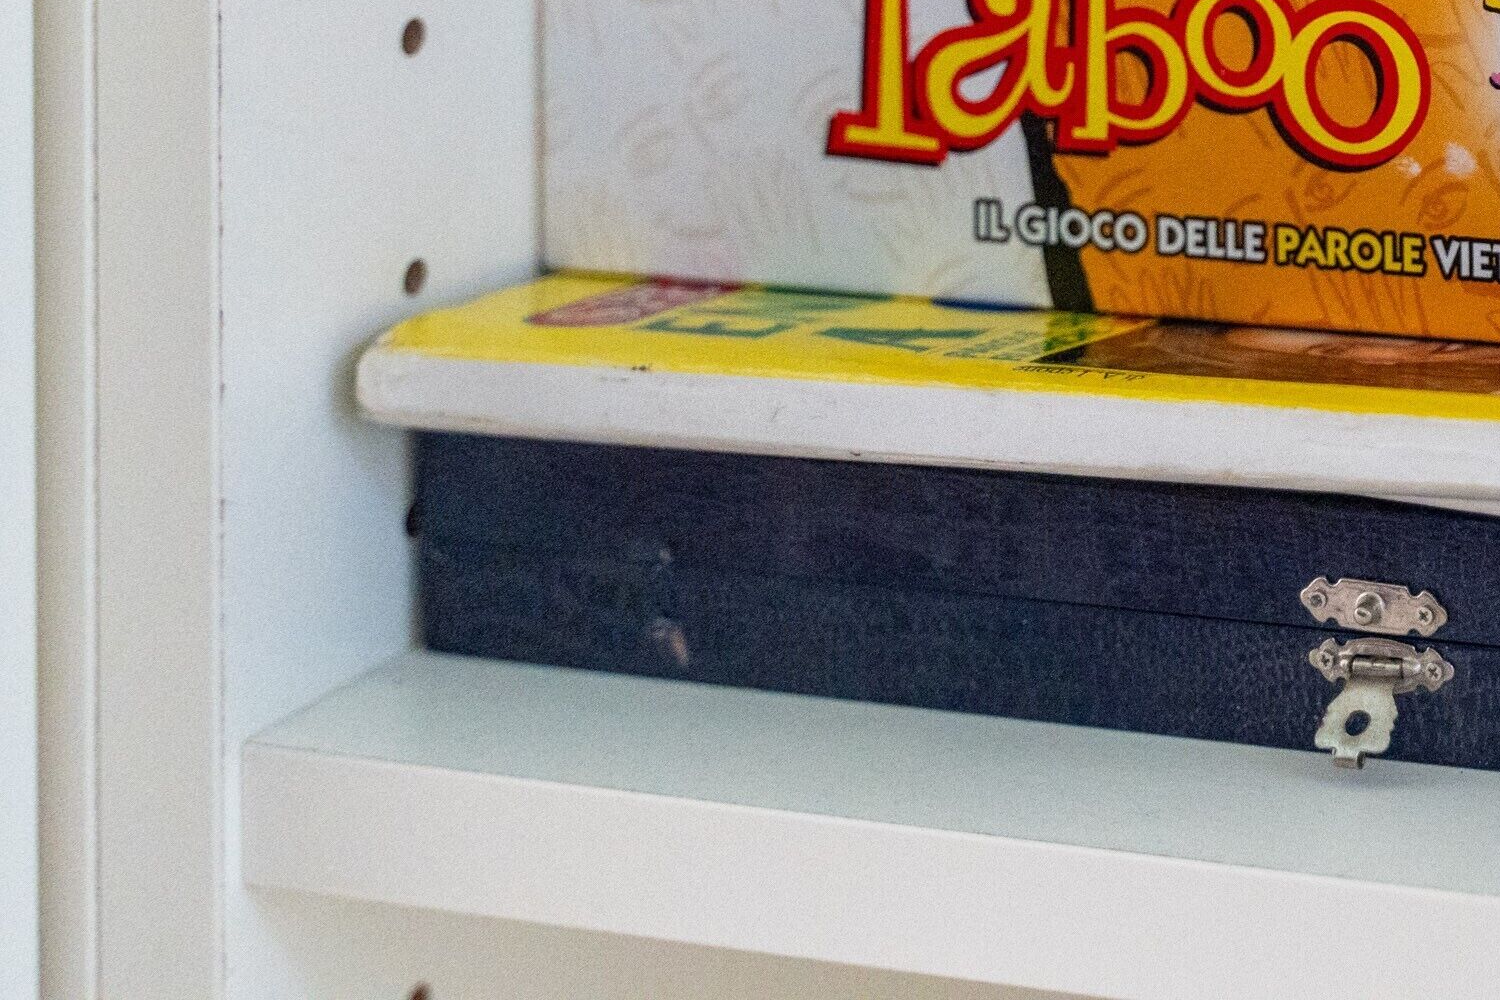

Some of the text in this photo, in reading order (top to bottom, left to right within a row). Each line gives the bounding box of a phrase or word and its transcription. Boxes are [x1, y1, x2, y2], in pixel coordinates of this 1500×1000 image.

[972, 197, 1011, 245] IL
[1013, 204, 1148, 254] GIOCO
[1154, 214, 1268, 264] DELLE
[1273, 223, 1428, 278] PAROLE
